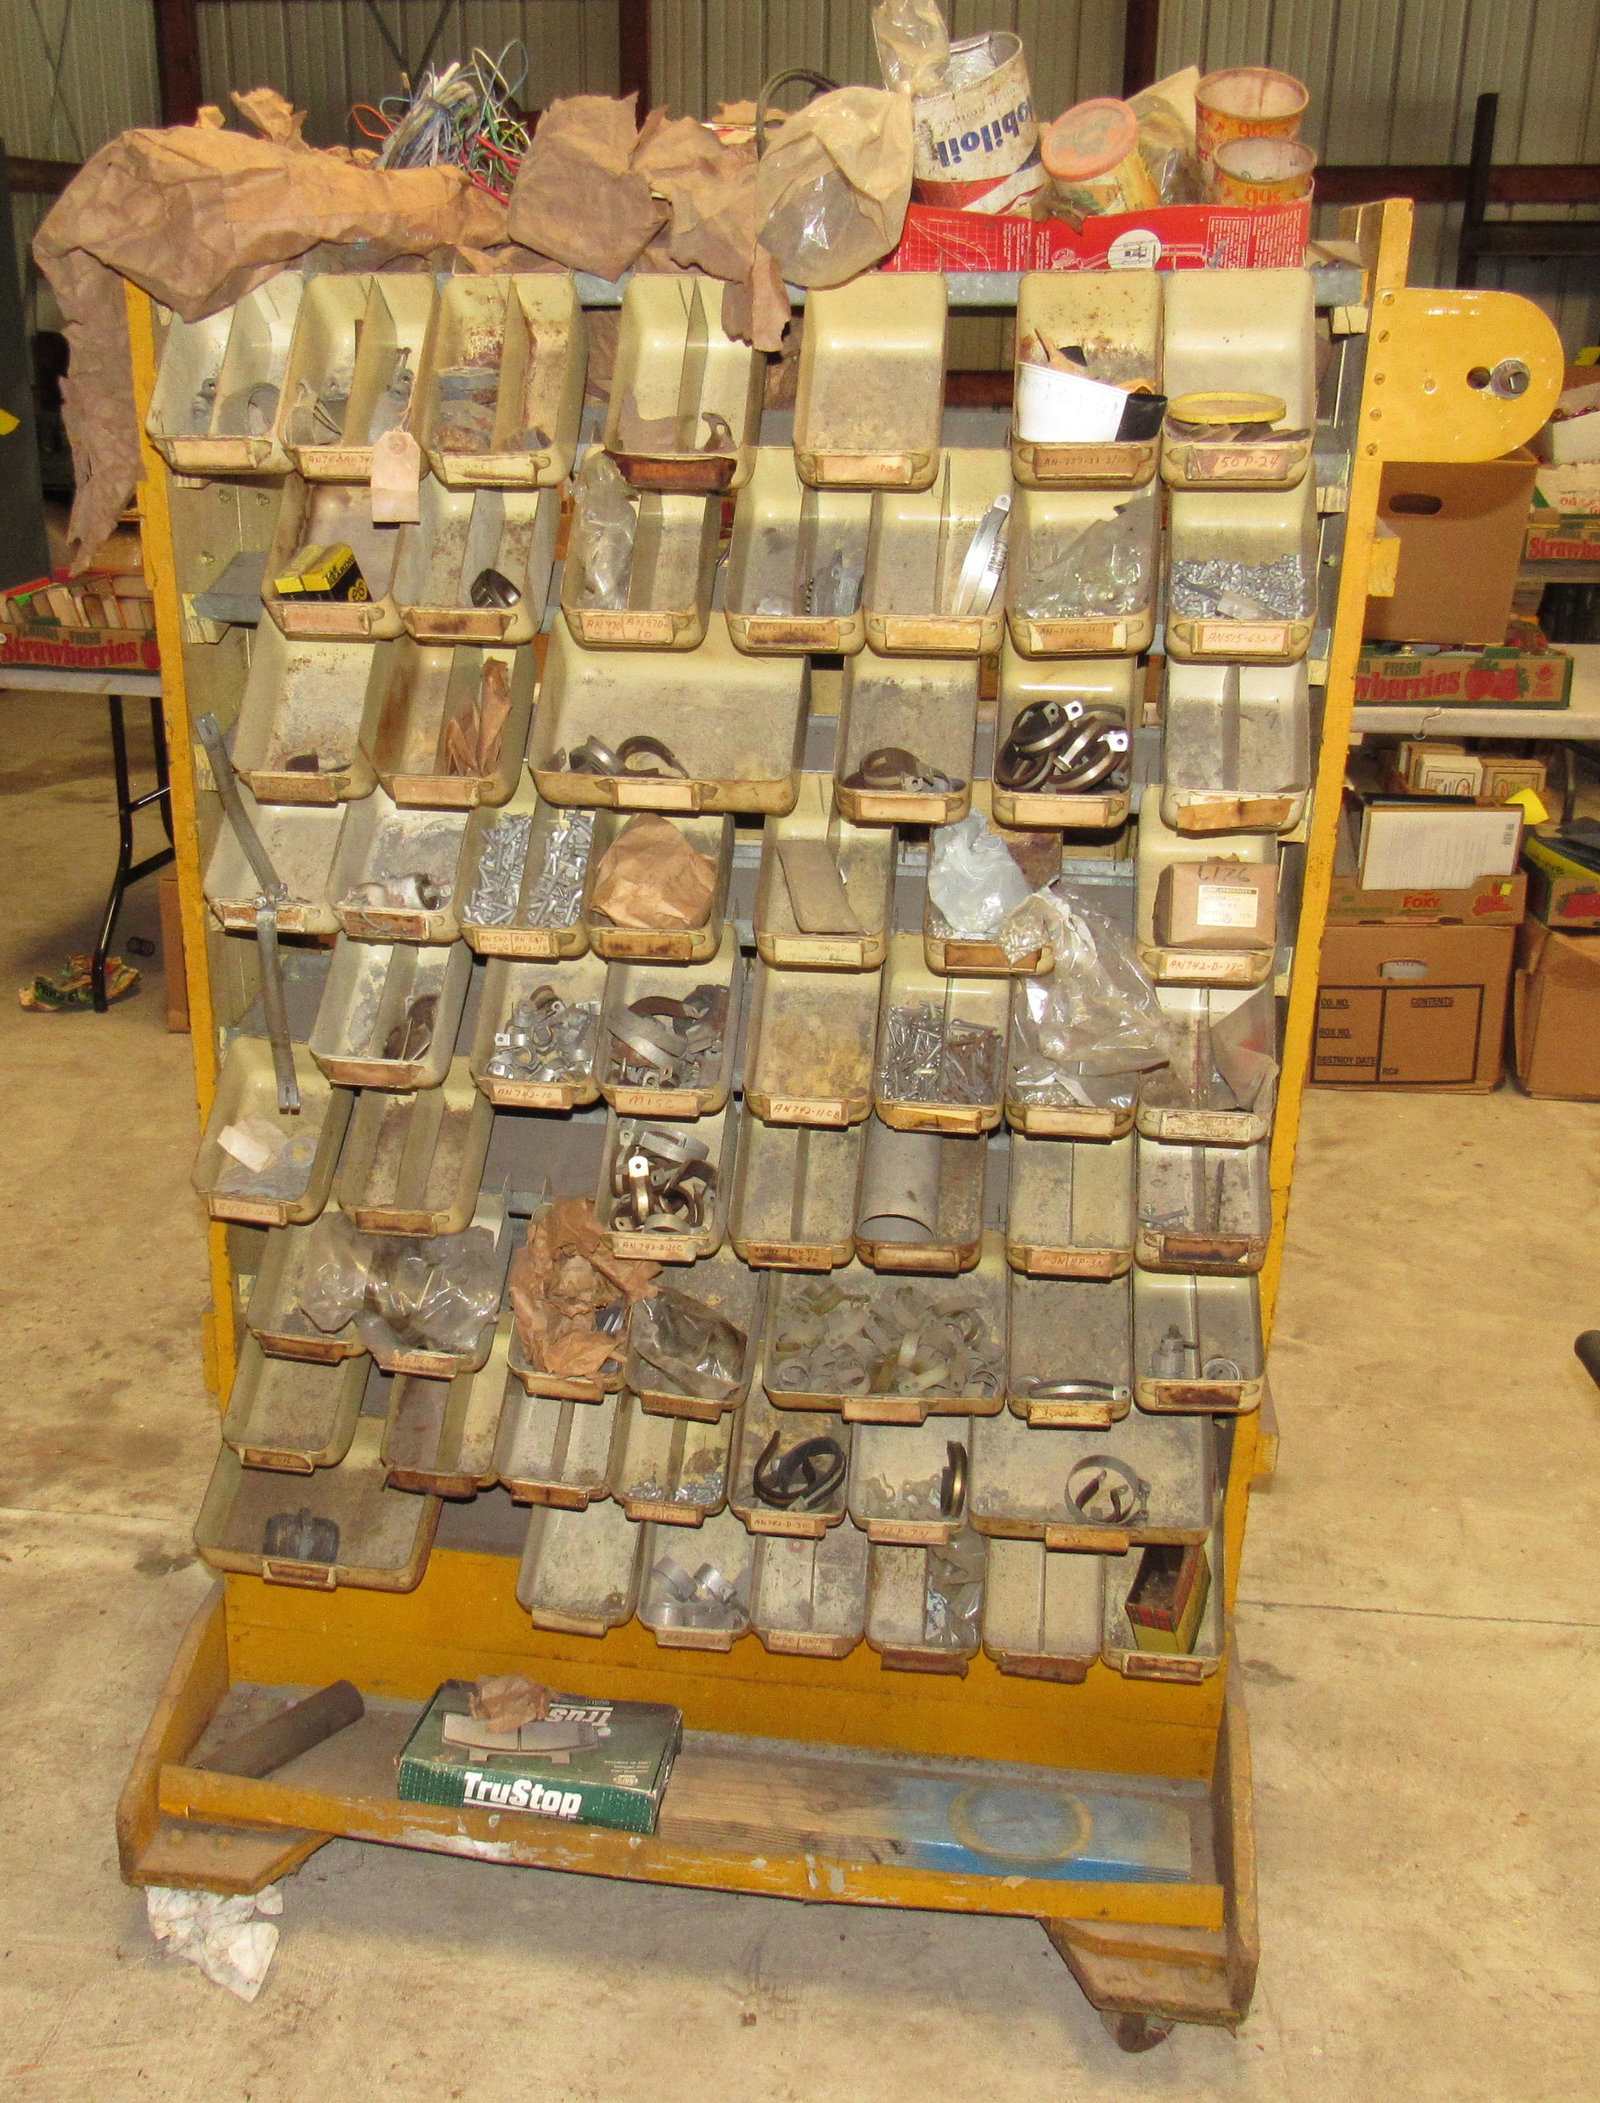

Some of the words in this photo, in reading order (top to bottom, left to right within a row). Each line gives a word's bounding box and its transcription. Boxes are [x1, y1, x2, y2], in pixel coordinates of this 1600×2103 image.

[936, 98, 1034, 168] obiloil
[1402, 896, 1440, 908] FOXY
[1410, 997, 1454, 1006] CONTENTS
[1317, 1056, 1353, 1065] DESTROY
[1355, 1056, 1376, 1065] DATE
[546, 1708, 612, 1727] TruS
[464, 1771, 583, 1817] TruStop
